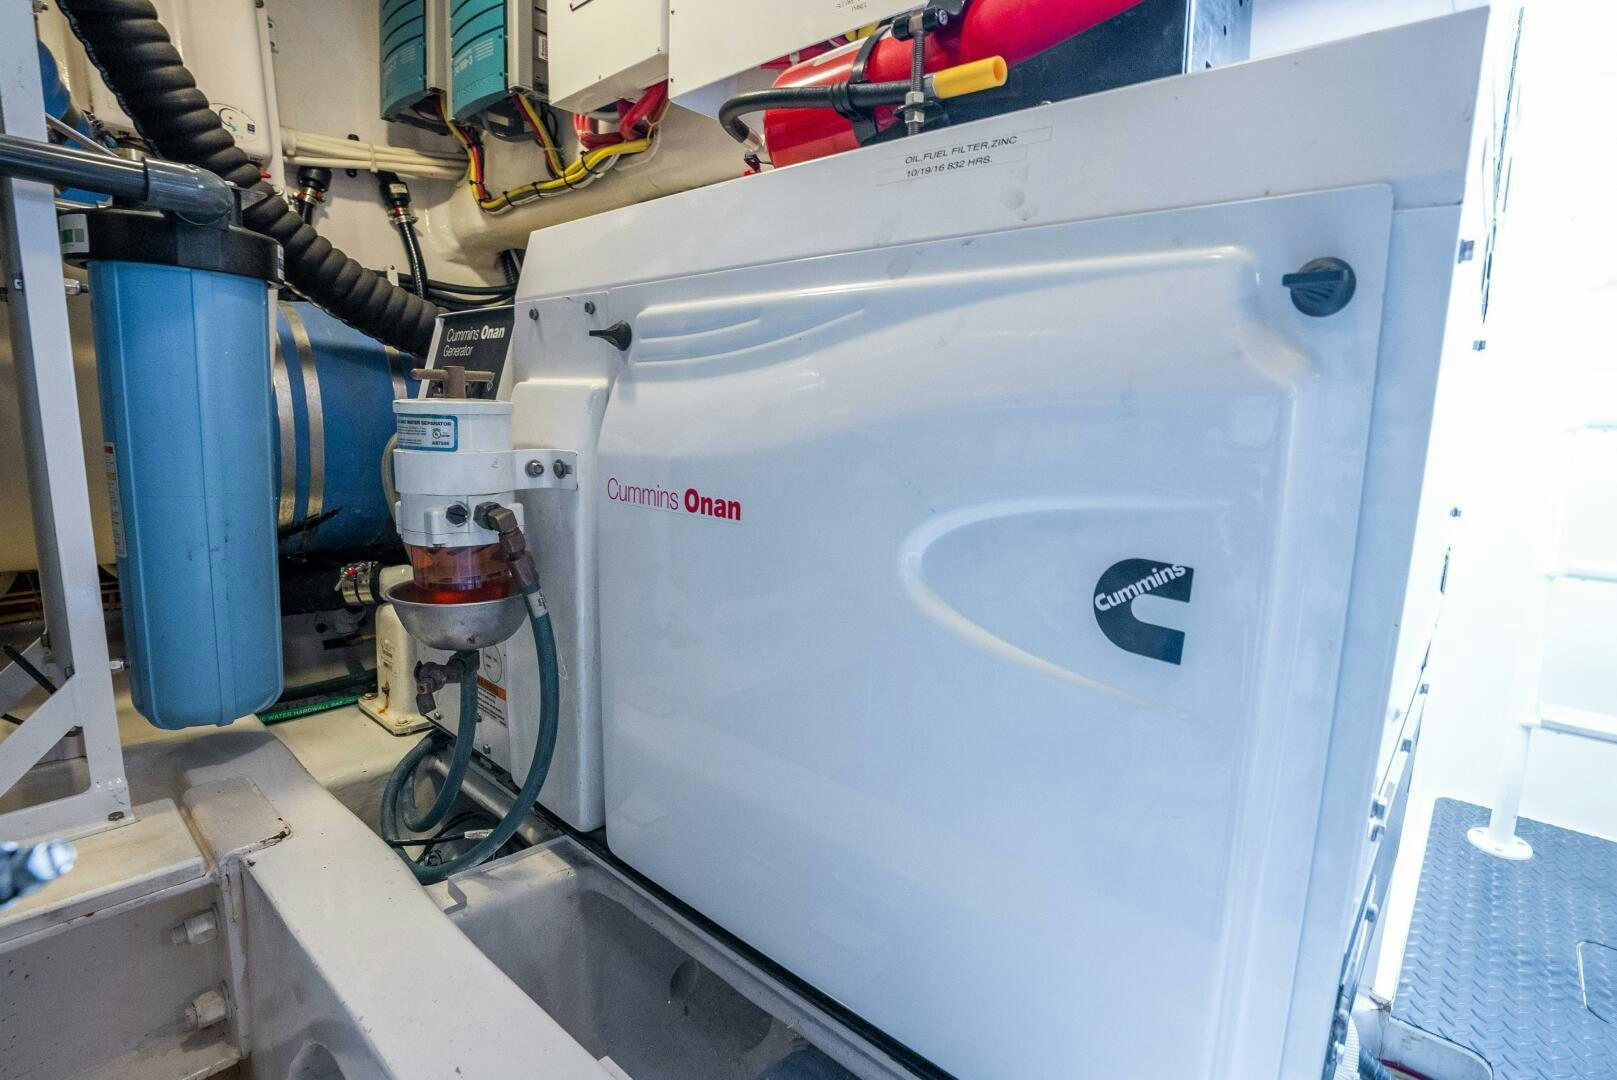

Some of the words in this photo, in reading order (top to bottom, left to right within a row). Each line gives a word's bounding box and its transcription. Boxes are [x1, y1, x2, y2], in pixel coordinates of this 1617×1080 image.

[907, 163, 946, 178] 10/19/16
[967, 155, 993, 167] HRS.
[446, 326, 480, 343] Cummins
[480, 324, 506, 340] Onan
[443, 344, 474, 357] Generator
[607, 477, 679, 510] Cummins
[684, 488, 741, 520] Onan
[1094, 564, 1187, 612] Cummins
[268, 710, 292, 721] WATER
[293, 704, 329, 716] HARDWALL
